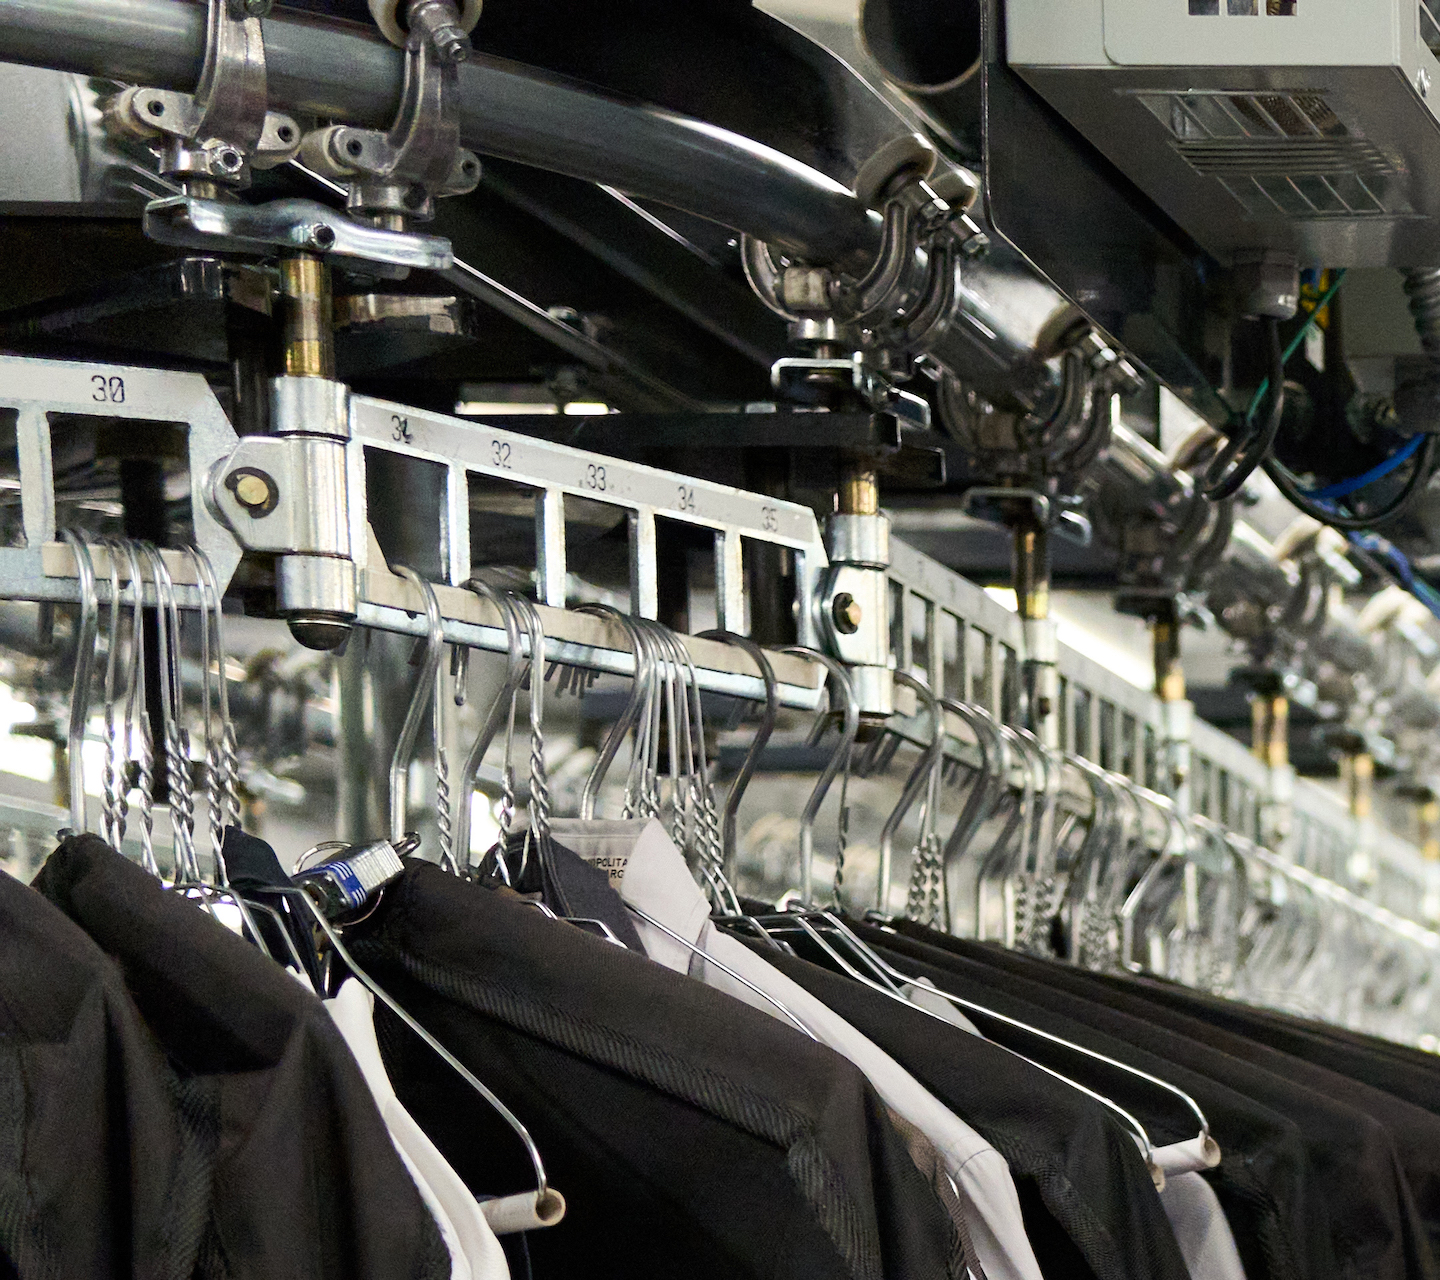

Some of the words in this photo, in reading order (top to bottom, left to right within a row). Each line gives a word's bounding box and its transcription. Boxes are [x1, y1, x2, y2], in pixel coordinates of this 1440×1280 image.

[91, 375, 125, 403] 30
[492, 440, 511, 469] 32
[587, 464, 606, 491] 33
[678, 486, 695, 512] 34
[762, 506, 778, 532] 35
[587, 857, 628, 868] POLITA
